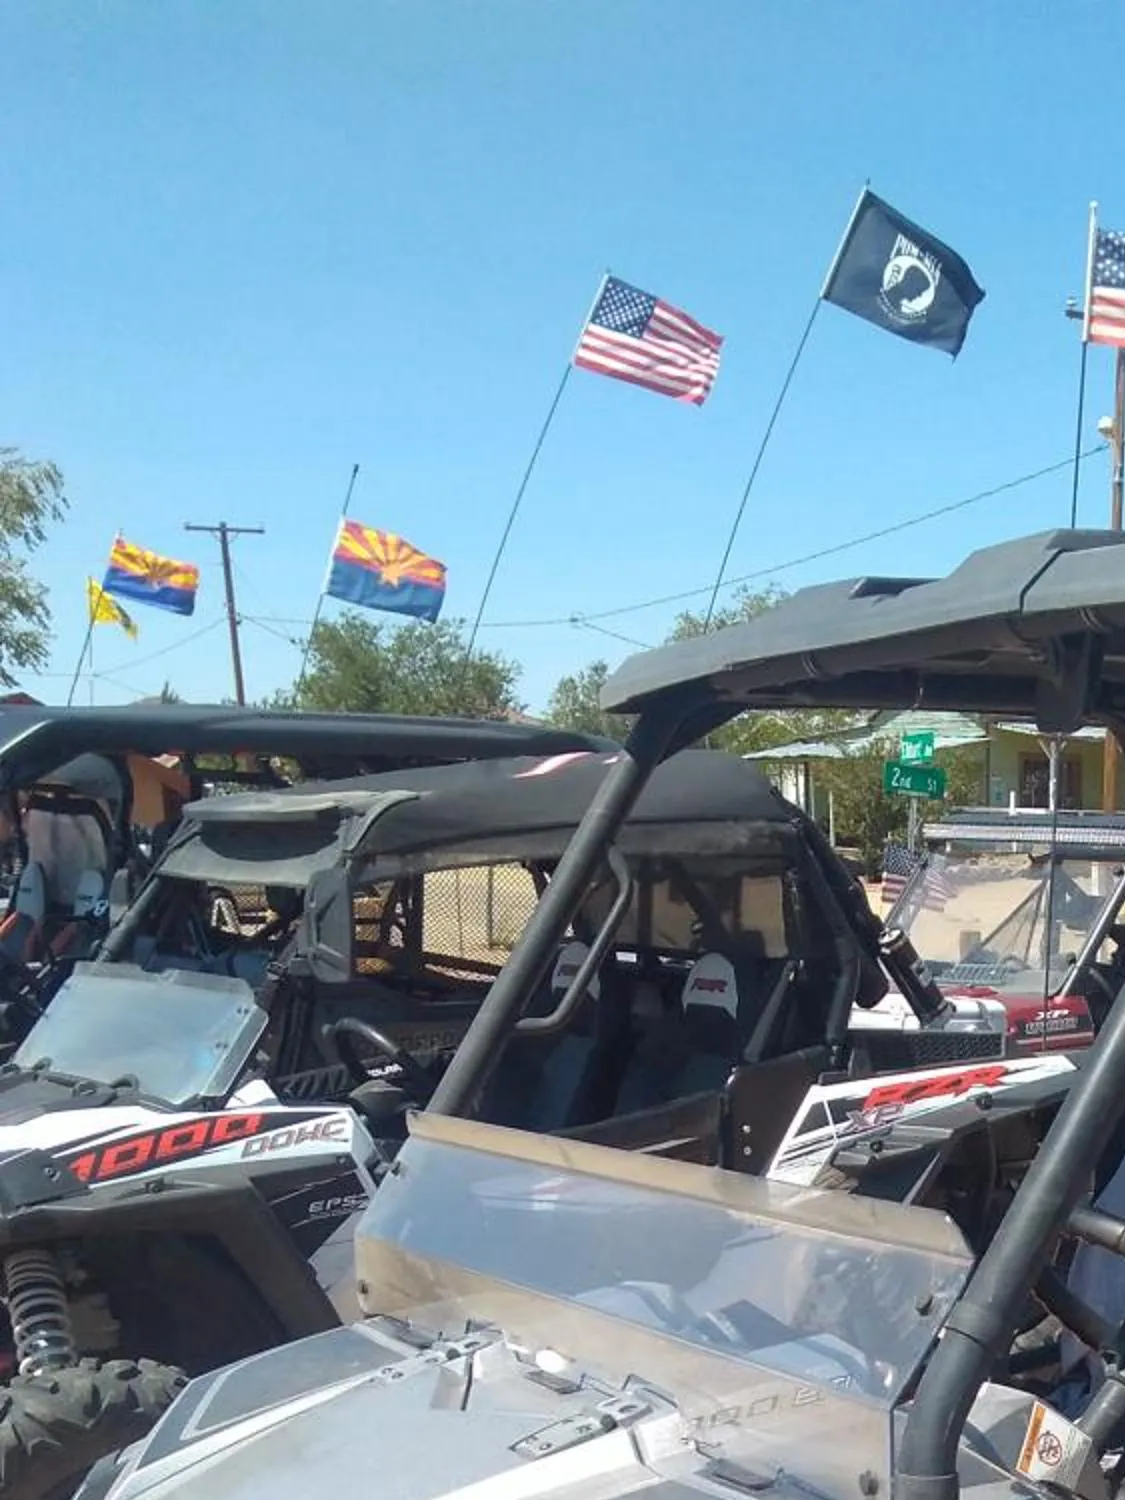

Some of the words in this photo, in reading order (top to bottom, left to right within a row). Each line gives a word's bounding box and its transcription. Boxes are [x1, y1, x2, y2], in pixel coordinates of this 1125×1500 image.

[863, 1065, 1009, 1112] RZR
[67, 1112, 266, 1183] 1000
[241, 1117, 348, 1159] DOHC
